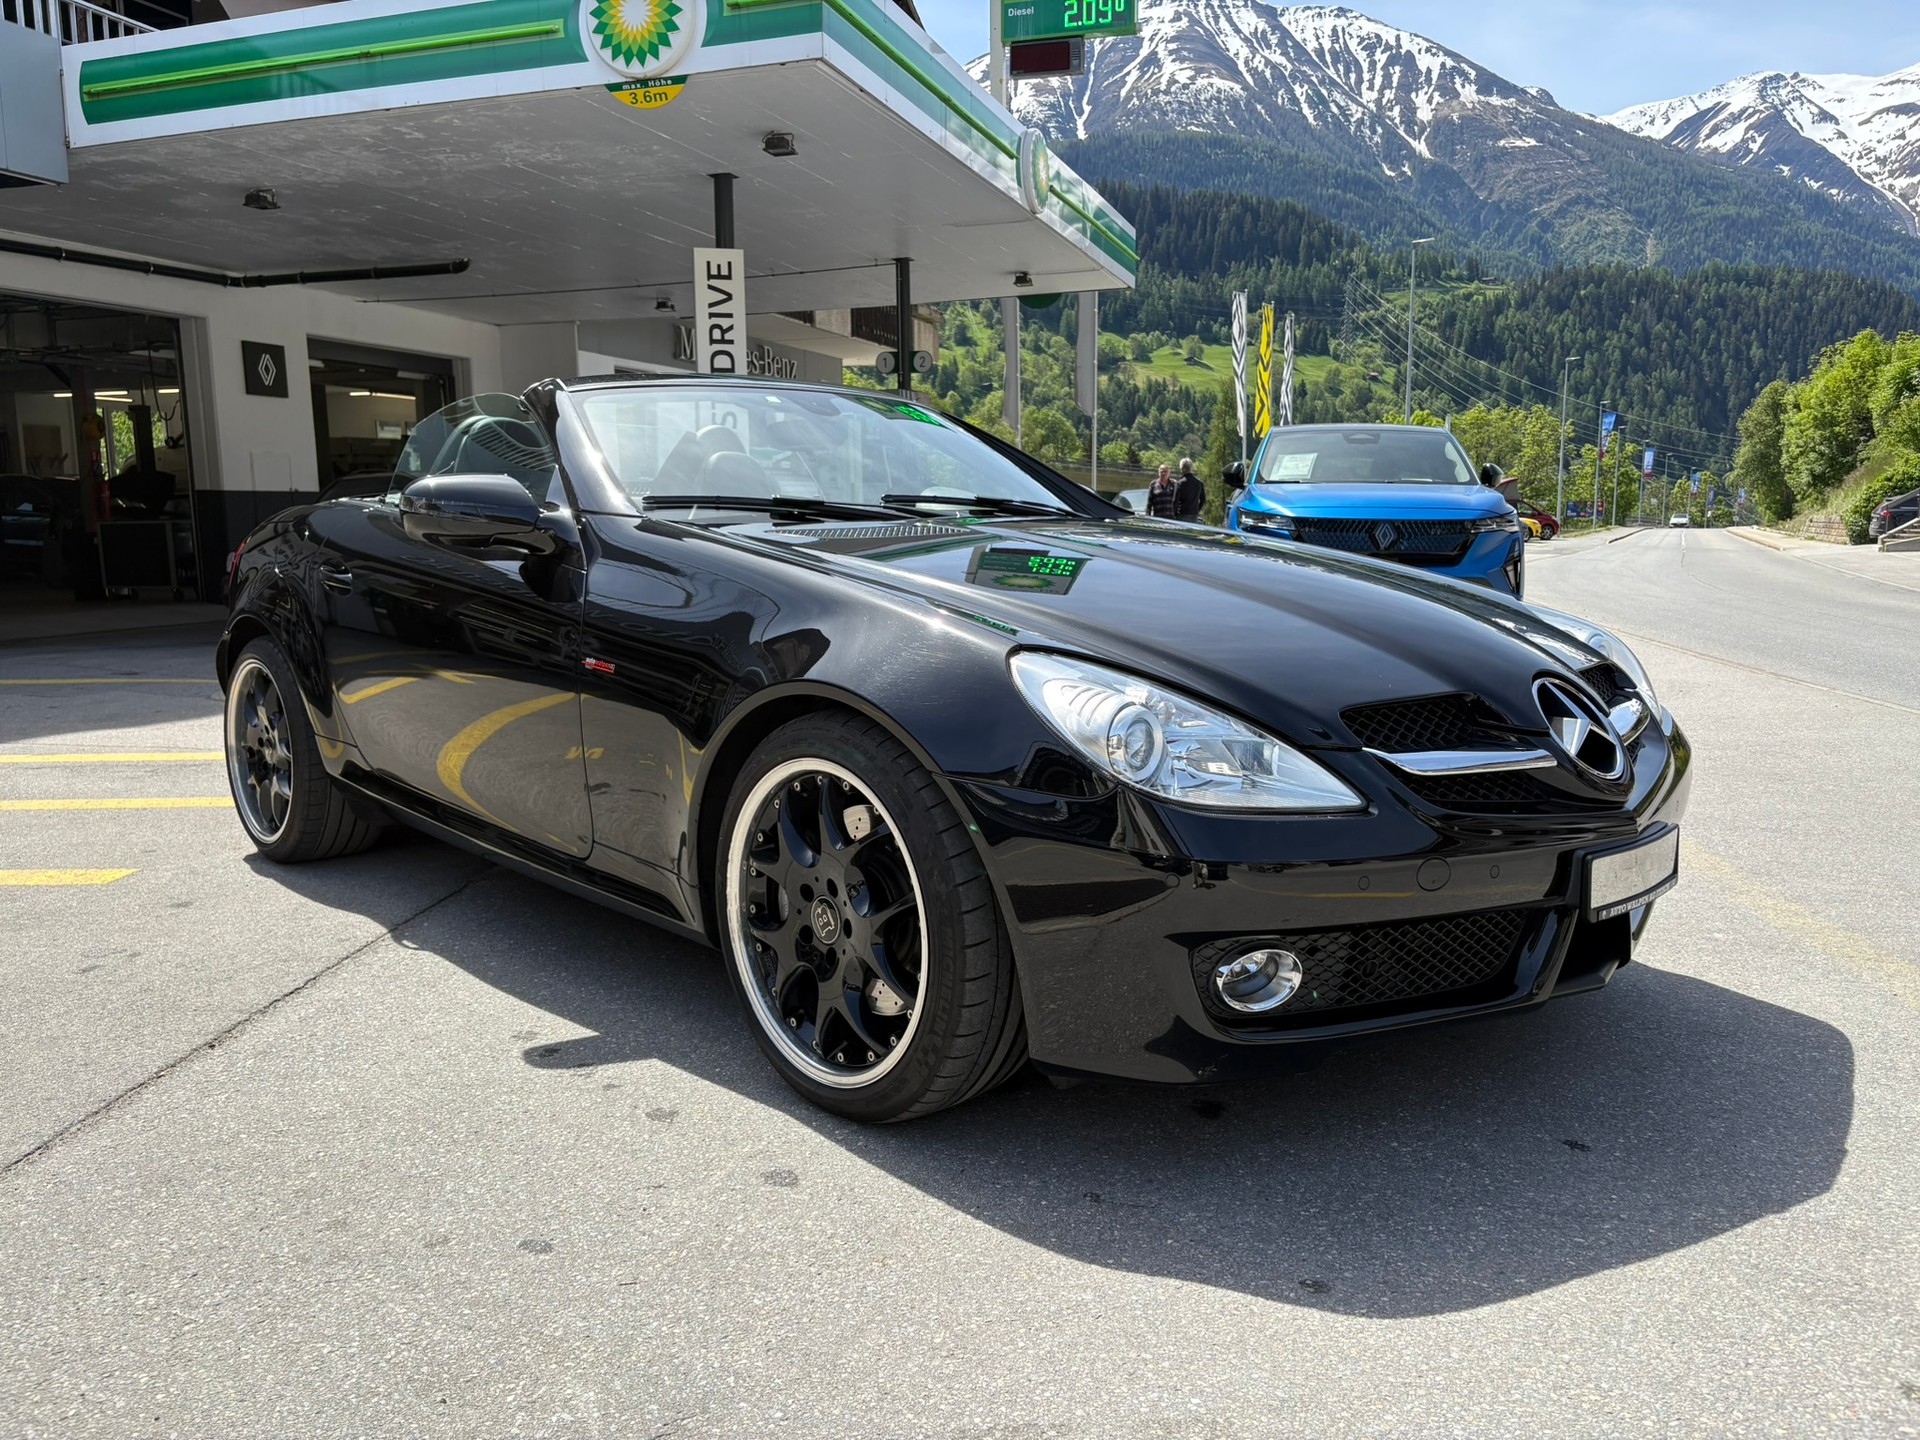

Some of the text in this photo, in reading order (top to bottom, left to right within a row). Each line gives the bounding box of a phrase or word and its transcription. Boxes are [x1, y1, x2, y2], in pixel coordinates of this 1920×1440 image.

[1008, 6, 1035, 17] Diesel
[648, 79, 673, 88] Höhe
[629, 90, 669, 105] 3.6m
[706, 260, 736, 374] DRIVE
[882, 357, 888, 369] 1
[919, 356, 926, 368] 2
[1609, 904, 1627, 917] AUTO
